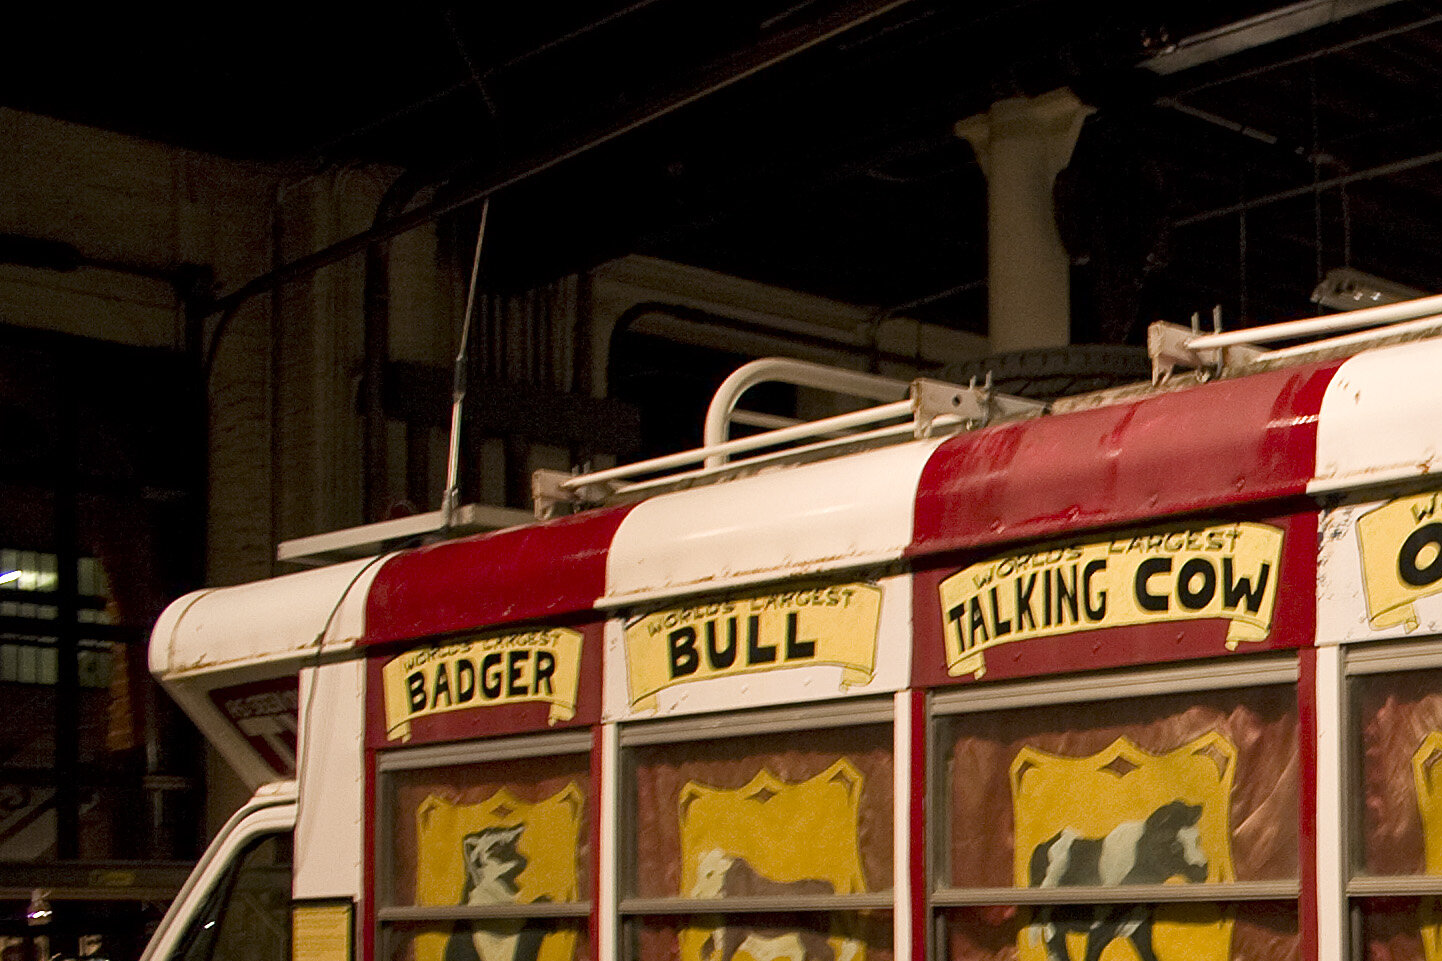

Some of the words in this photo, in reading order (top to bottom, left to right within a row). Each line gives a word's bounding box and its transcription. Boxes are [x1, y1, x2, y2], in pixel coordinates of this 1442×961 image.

[948, 557, 1108, 653] TALKING
[1132, 555, 1271, 617] COW
[667, 612, 818, 681] BULL
[404, 649, 556, 717] BADGER
